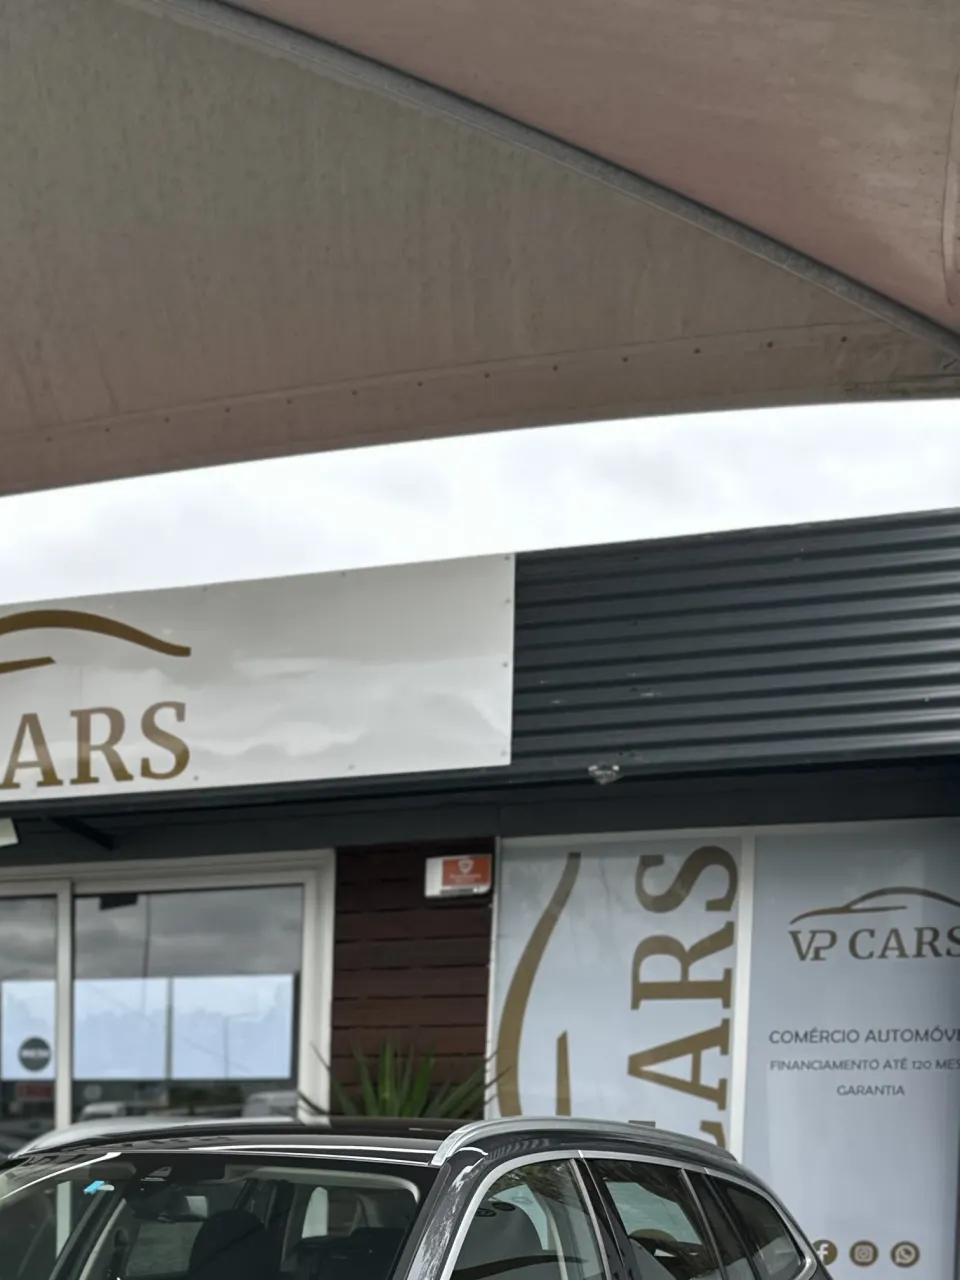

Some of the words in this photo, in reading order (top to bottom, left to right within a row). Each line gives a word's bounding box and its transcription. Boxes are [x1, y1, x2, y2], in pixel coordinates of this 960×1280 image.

[788, 929, 837, 961] VP
[848, 925, 960, 960] CARS
[769, 1026, 860, 1044] COMÉRCIO
[769, 1059, 880, 1071] FINANCIAMENTO
[882, 1057, 908, 1070] ATÉ
[912, 1059, 932, 1070] 120
[836, 1085, 905, 1096] GARANTIA
